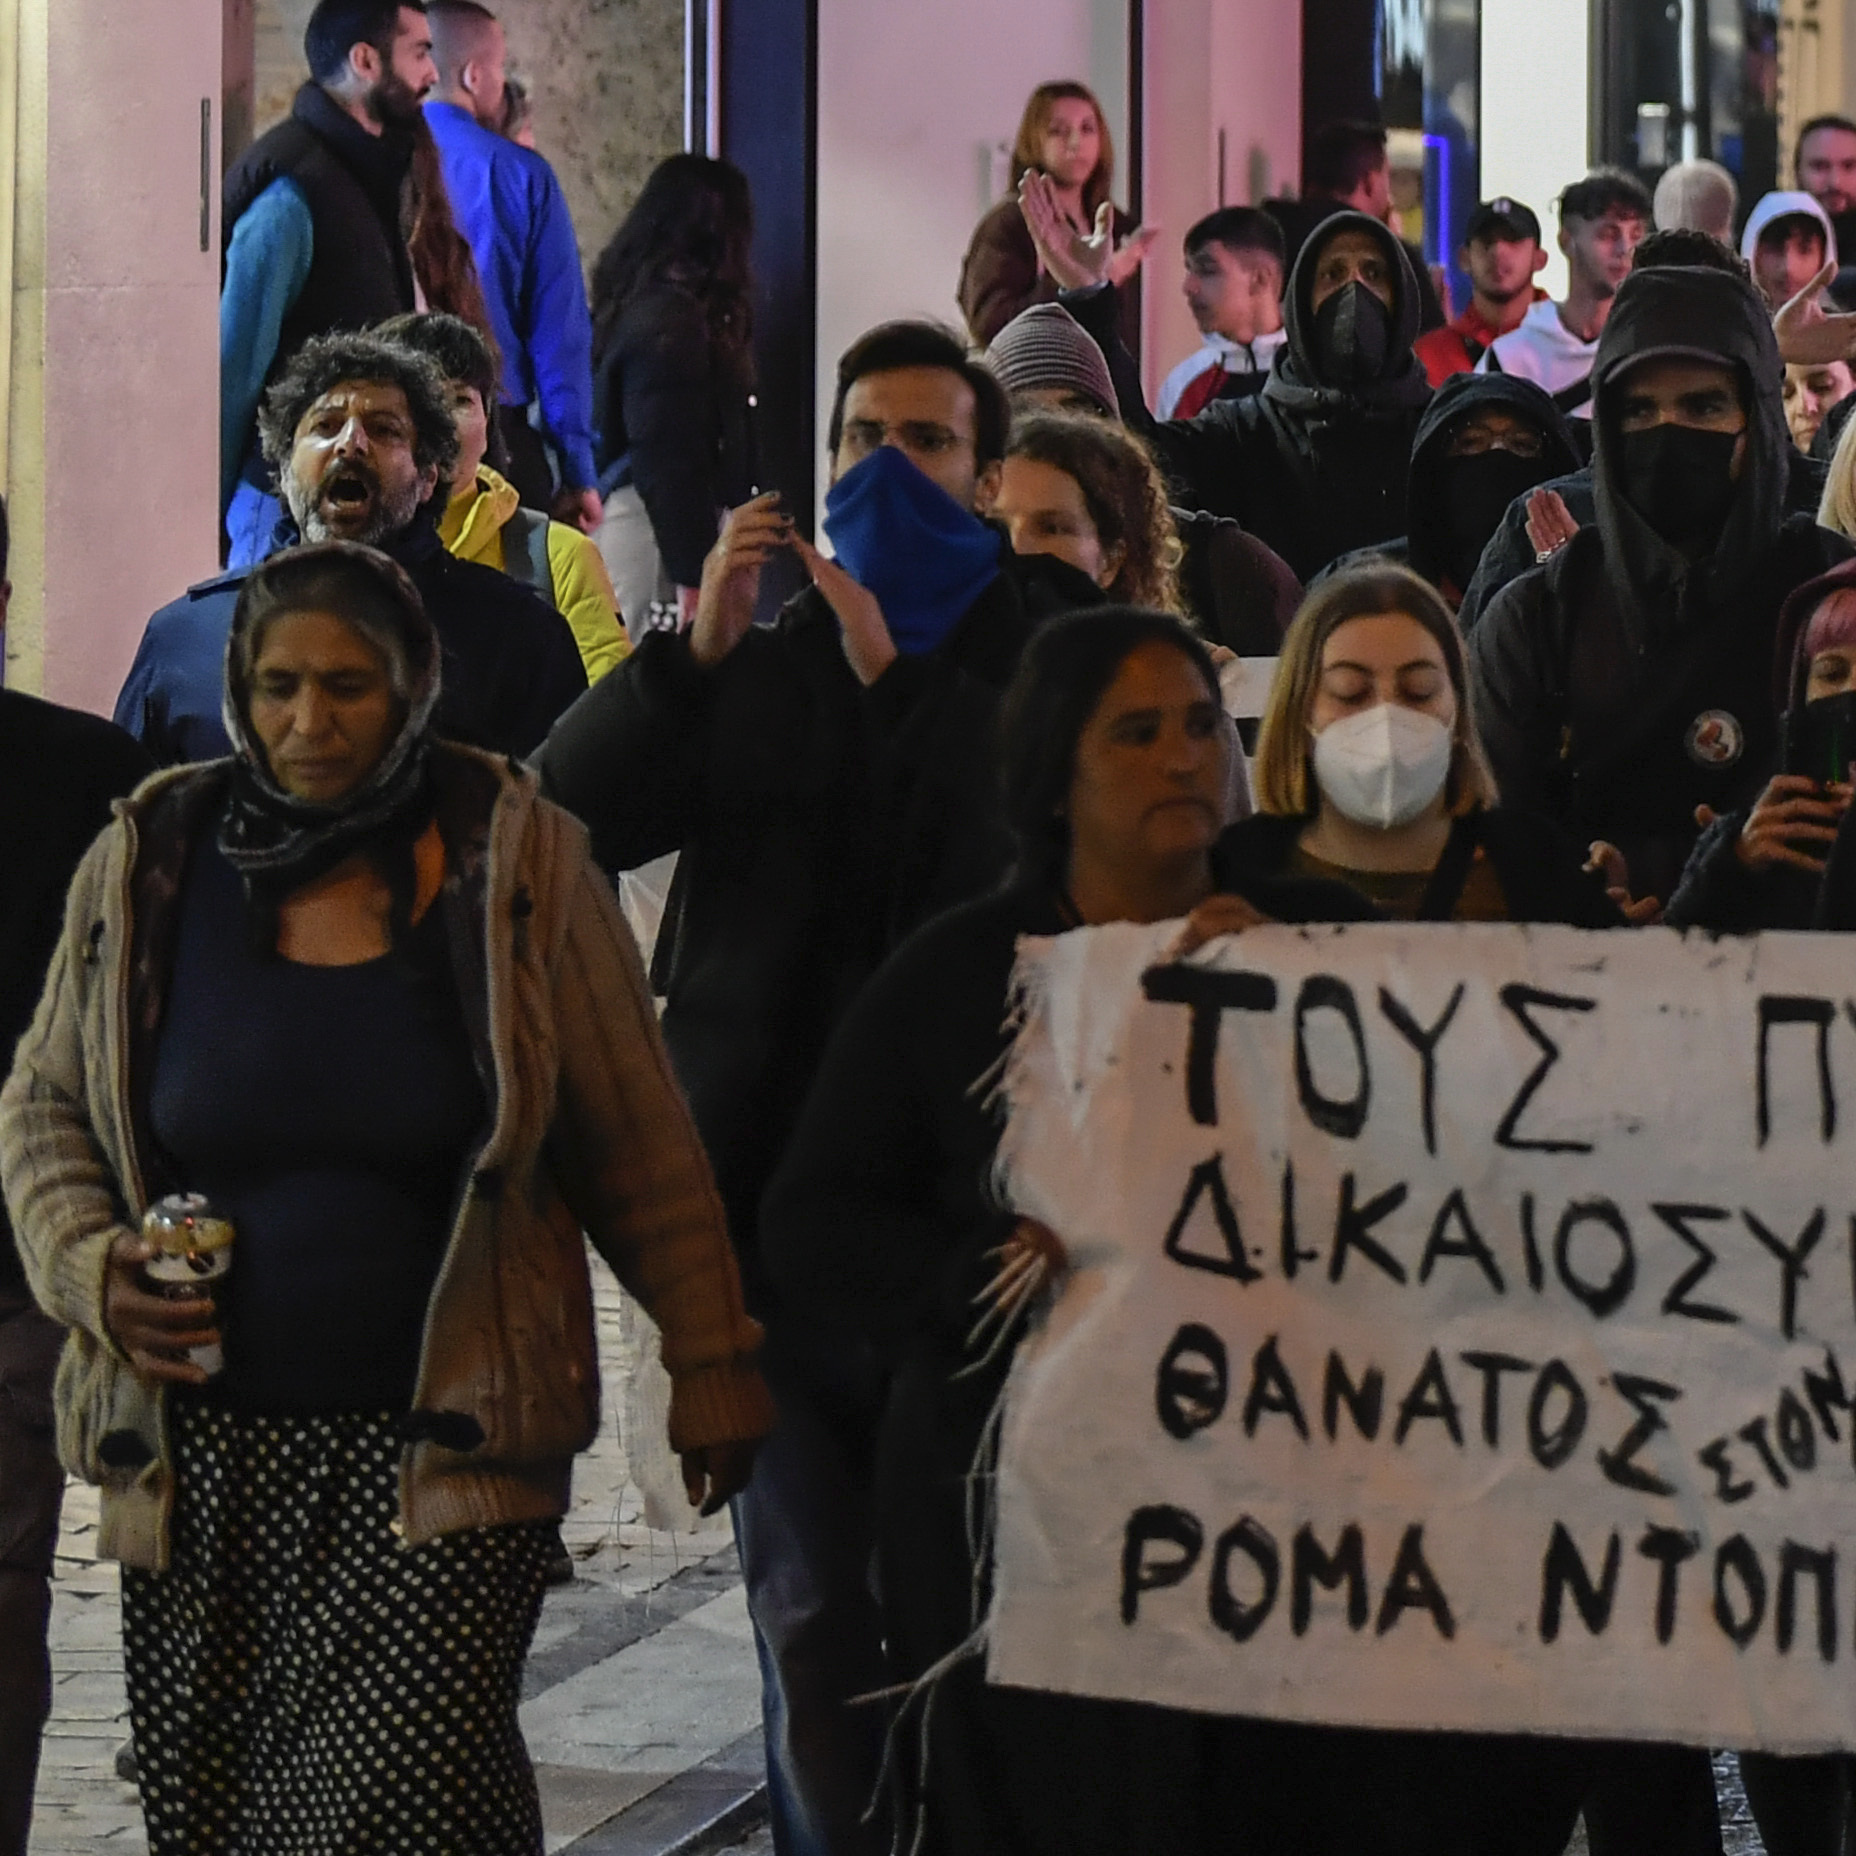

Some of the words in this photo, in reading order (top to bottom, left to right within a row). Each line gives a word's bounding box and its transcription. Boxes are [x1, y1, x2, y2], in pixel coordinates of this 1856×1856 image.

[1140, 964, 1598, 1156] ΤΟΥΣ
[1156, 1324, 1683, 1497] ΘΑΝΑΤΟΣ
[1698, 1347, 1855, 1504] ΣΤΟΝ
[1120, 1503, 1457, 1644] ΡΟΜΑ
